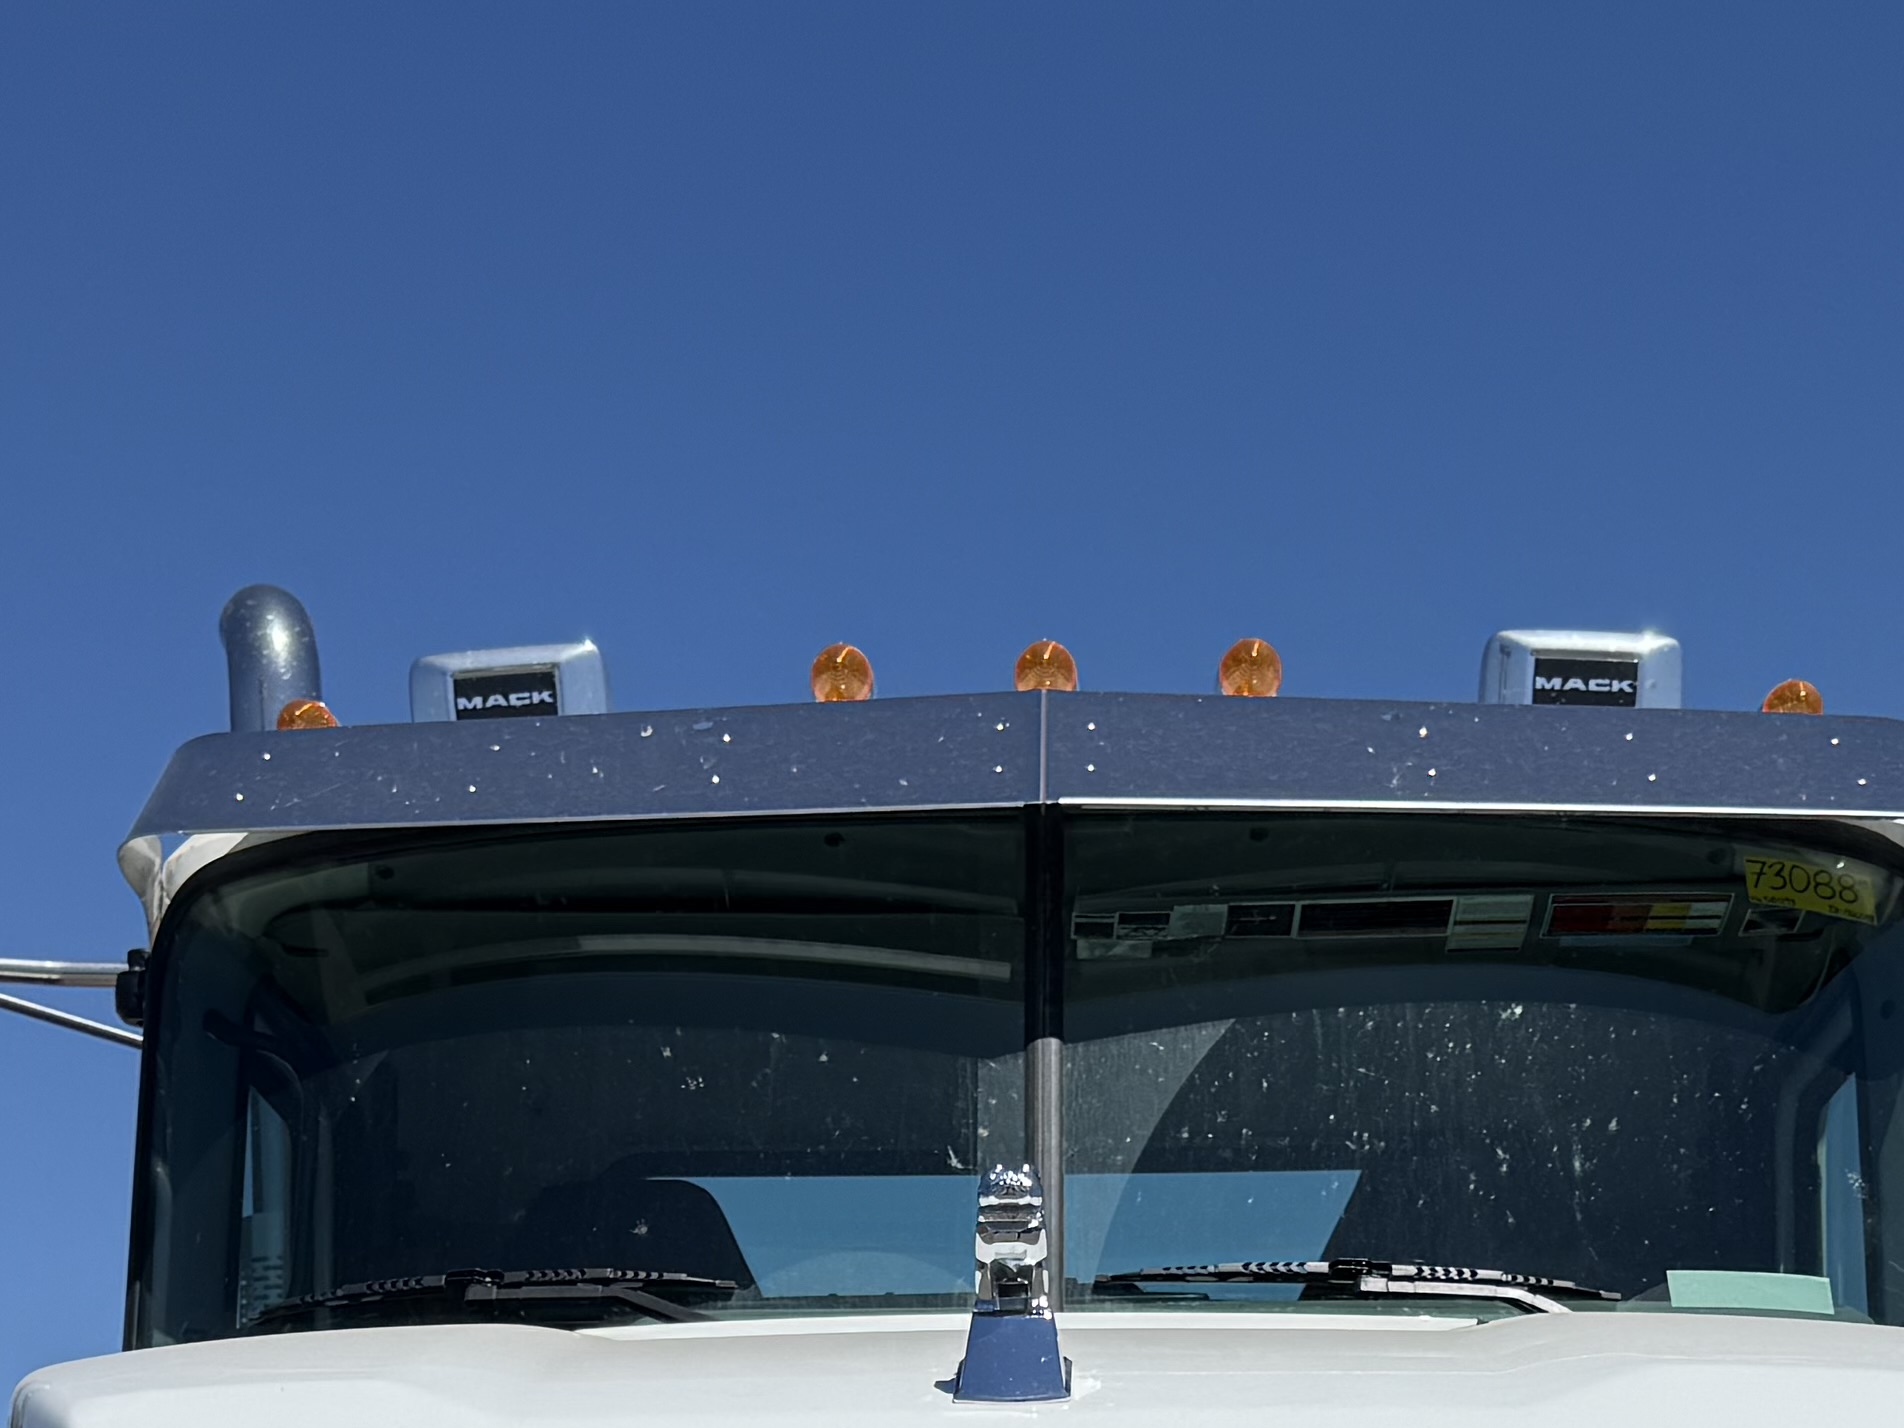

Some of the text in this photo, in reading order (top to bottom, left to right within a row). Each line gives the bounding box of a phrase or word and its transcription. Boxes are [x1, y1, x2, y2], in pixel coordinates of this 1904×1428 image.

[1535, 676, 1634, 693] MACK
[457, 690, 554, 710] MACK
[1746, 859, 1859, 903] 73088
